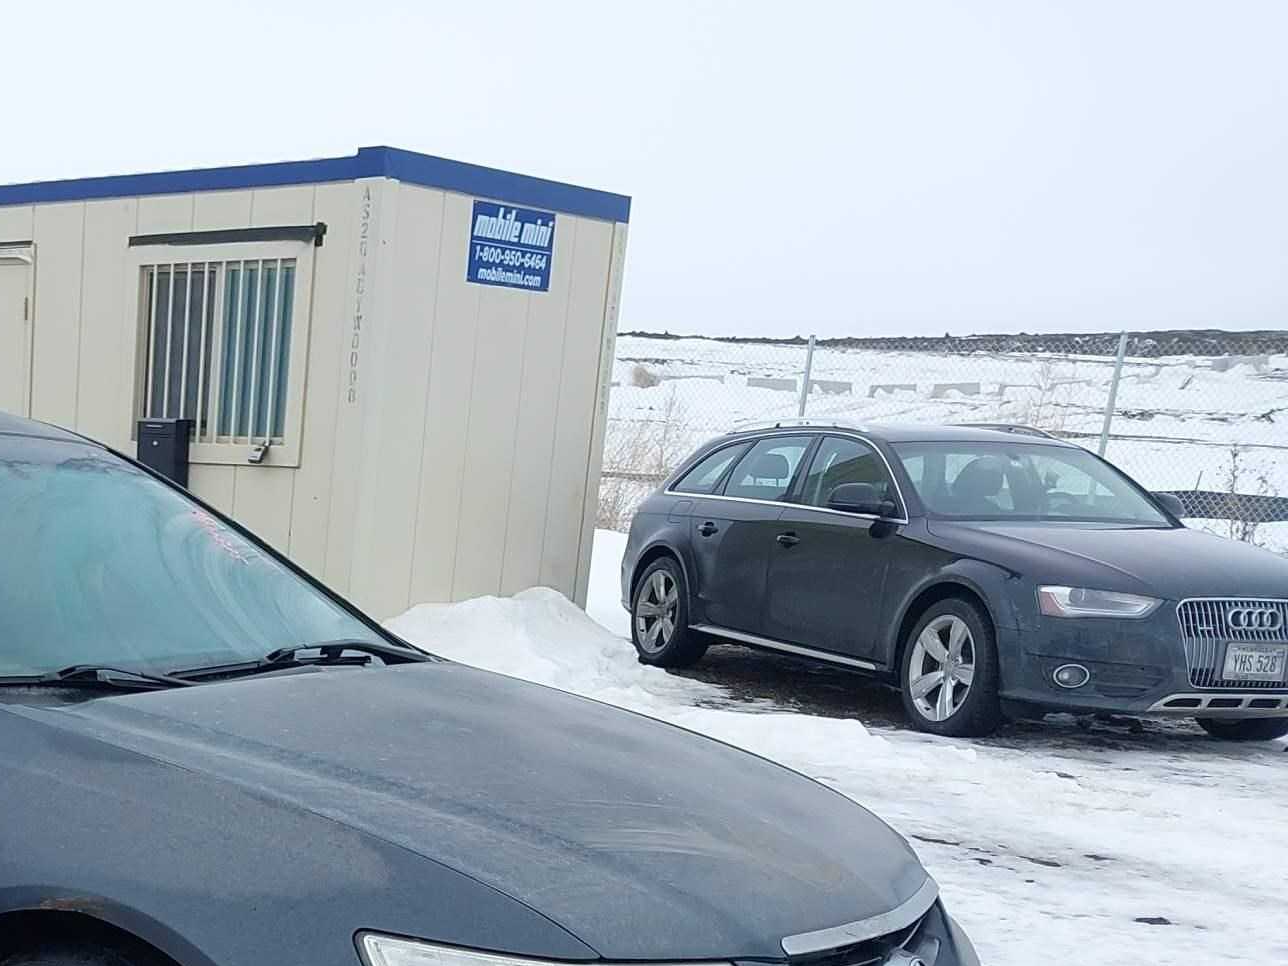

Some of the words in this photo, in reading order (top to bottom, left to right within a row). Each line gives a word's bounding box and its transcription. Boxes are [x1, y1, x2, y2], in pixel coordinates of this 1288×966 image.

[474, 208, 521, 243] mobile
[520, 219, 554, 248] mini
[475, 245, 547, 271] 1-800-950-6464
[477, 266, 542, 287] mobilemini.com
